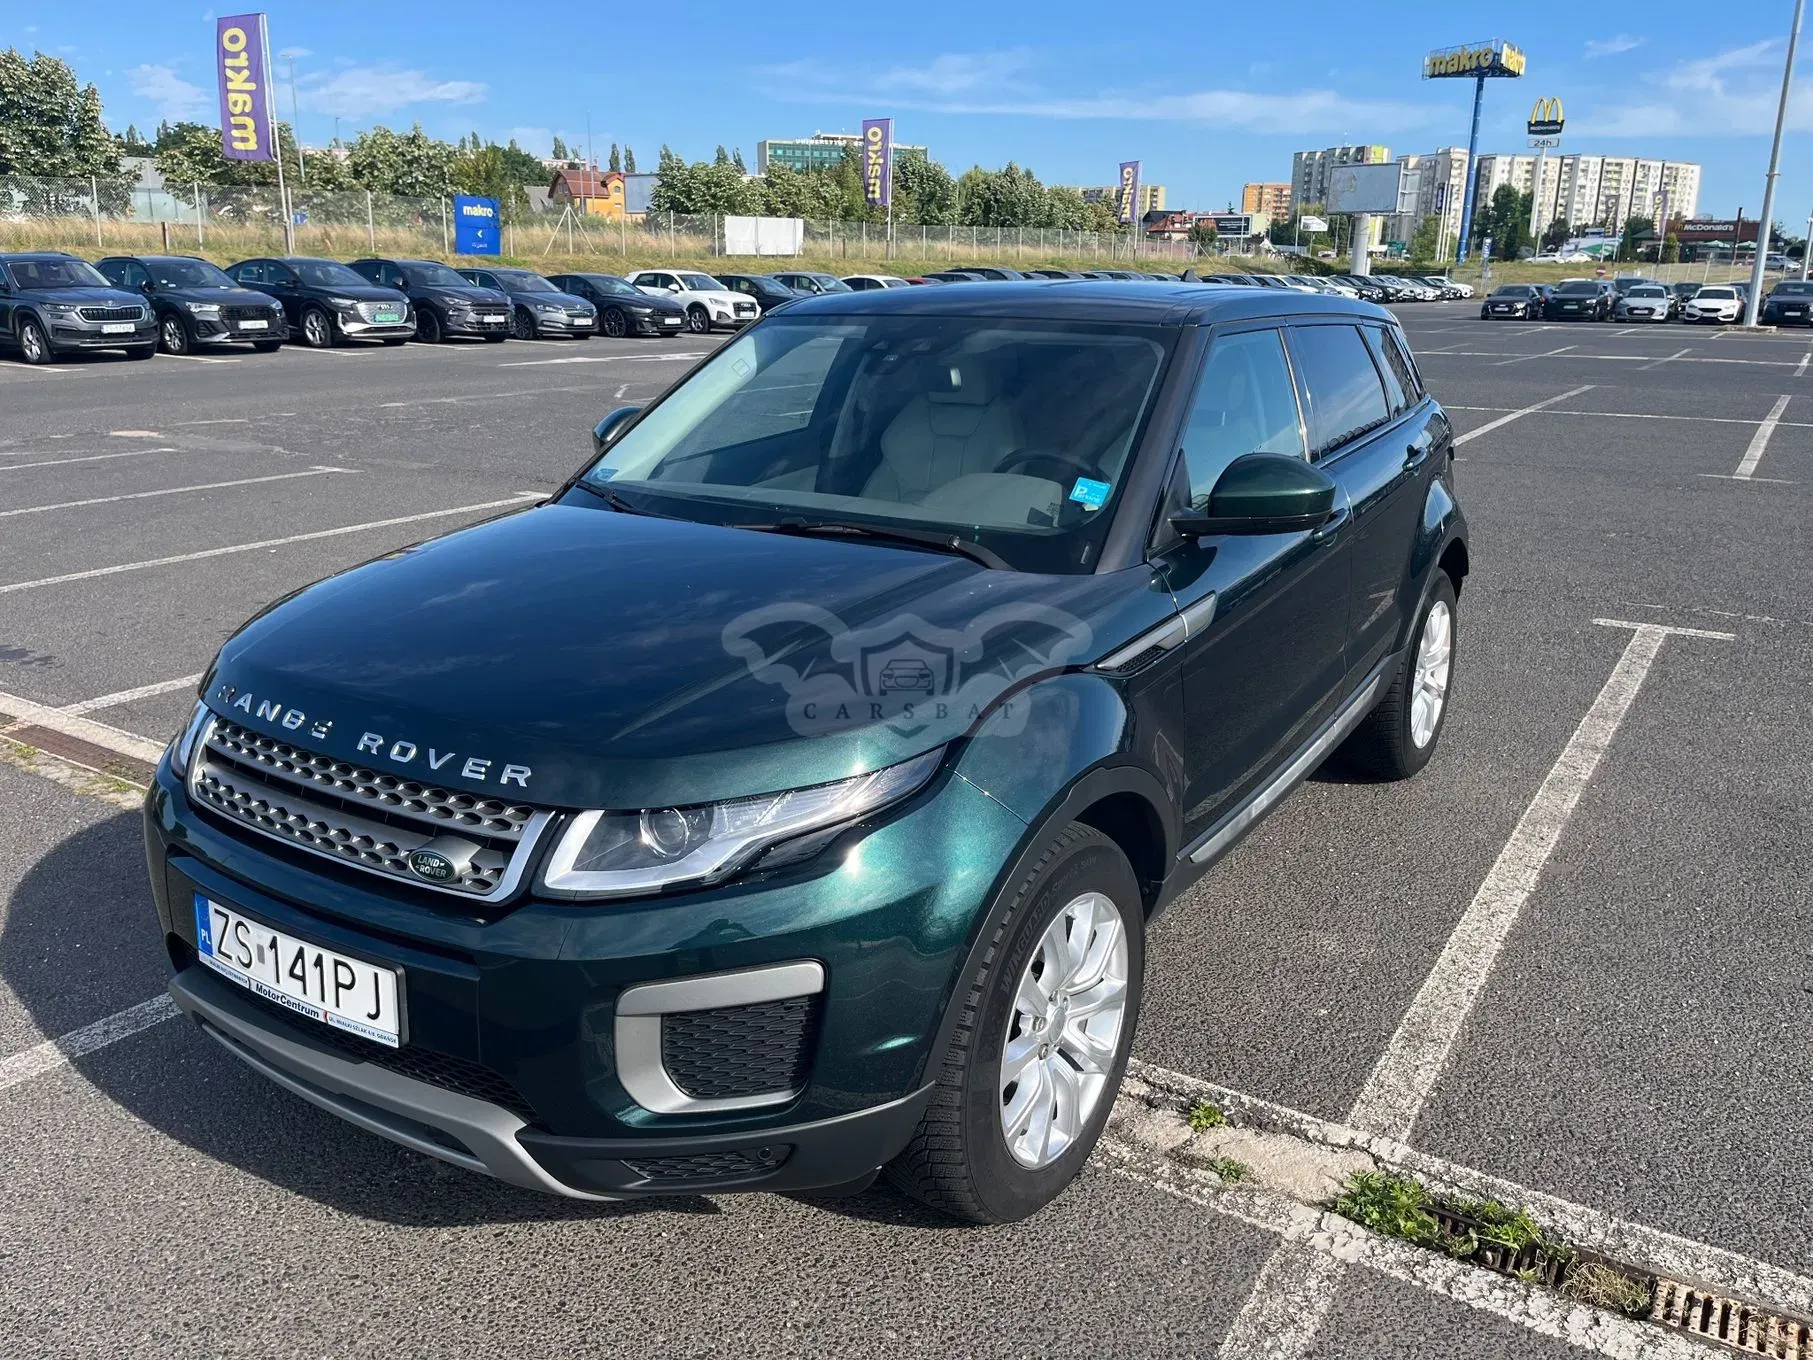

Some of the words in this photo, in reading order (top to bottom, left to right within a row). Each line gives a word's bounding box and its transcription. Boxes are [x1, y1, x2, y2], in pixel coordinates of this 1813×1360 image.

[1429, 48, 1494, 74] makro
[1503, 47, 1525, 75] makro
[222, 27, 257, 151] makro
[867, 126, 884, 199] makro
[463, 203, 494, 218] makro
[1684, 223, 1734, 232] McDonald's
[217, 684, 334, 740] RANGE
[356, 731, 532, 788] ROVER
[418, 864, 448, 878] ROVER
[200, 928, 212, 946] PL
[214, 908, 253, 969] ZS
[268, 935, 381, 1021] 141PJ
[255, 983, 320, 1019] MotorCentrum
